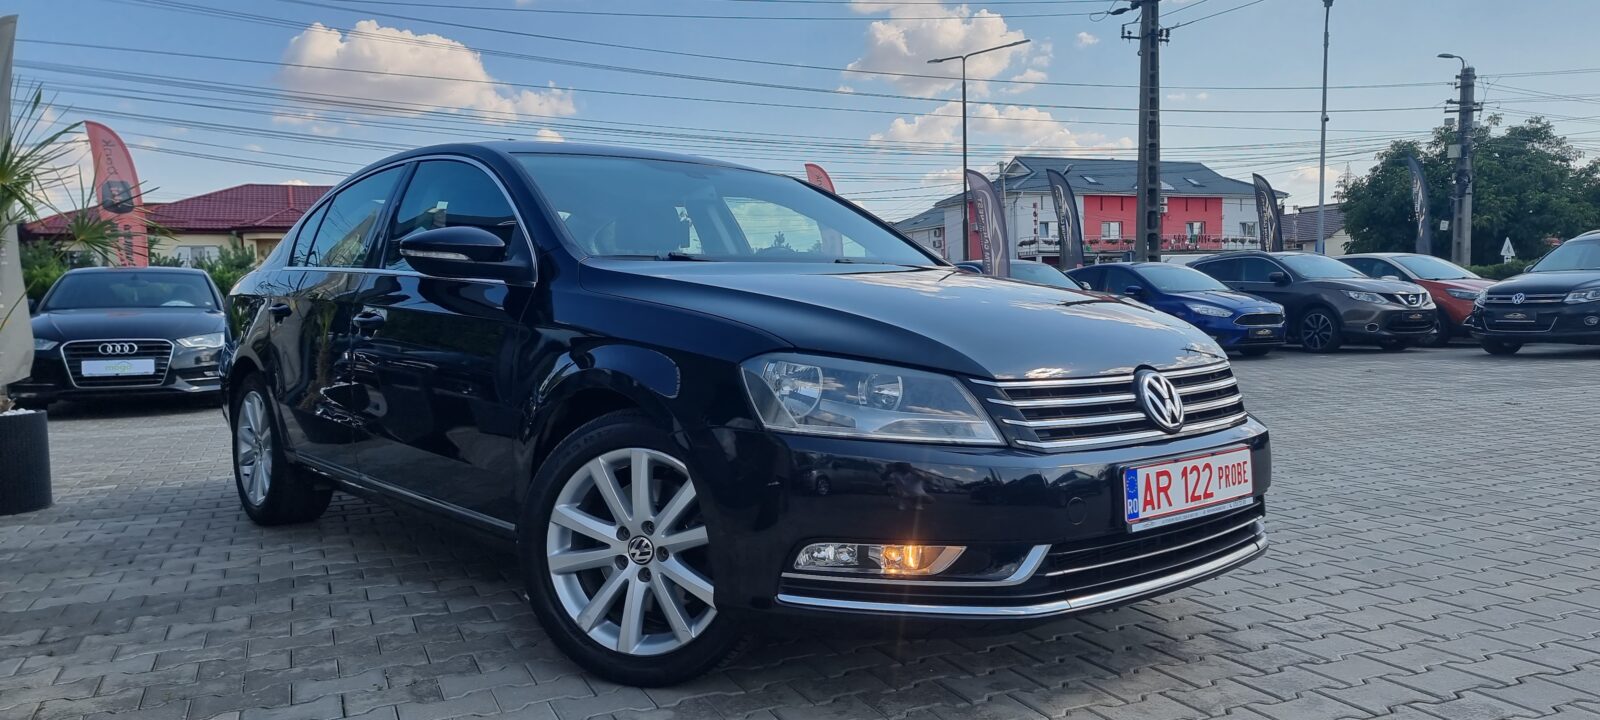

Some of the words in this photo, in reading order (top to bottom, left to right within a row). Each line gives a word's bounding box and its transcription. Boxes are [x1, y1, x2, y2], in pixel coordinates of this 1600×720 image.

[1142, 469, 1173, 512] AR
[1181, 463, 1214, 504] 122
[1218, 461, 1248, 490] PROBE
[1128, 498, 1138, 515] RO
